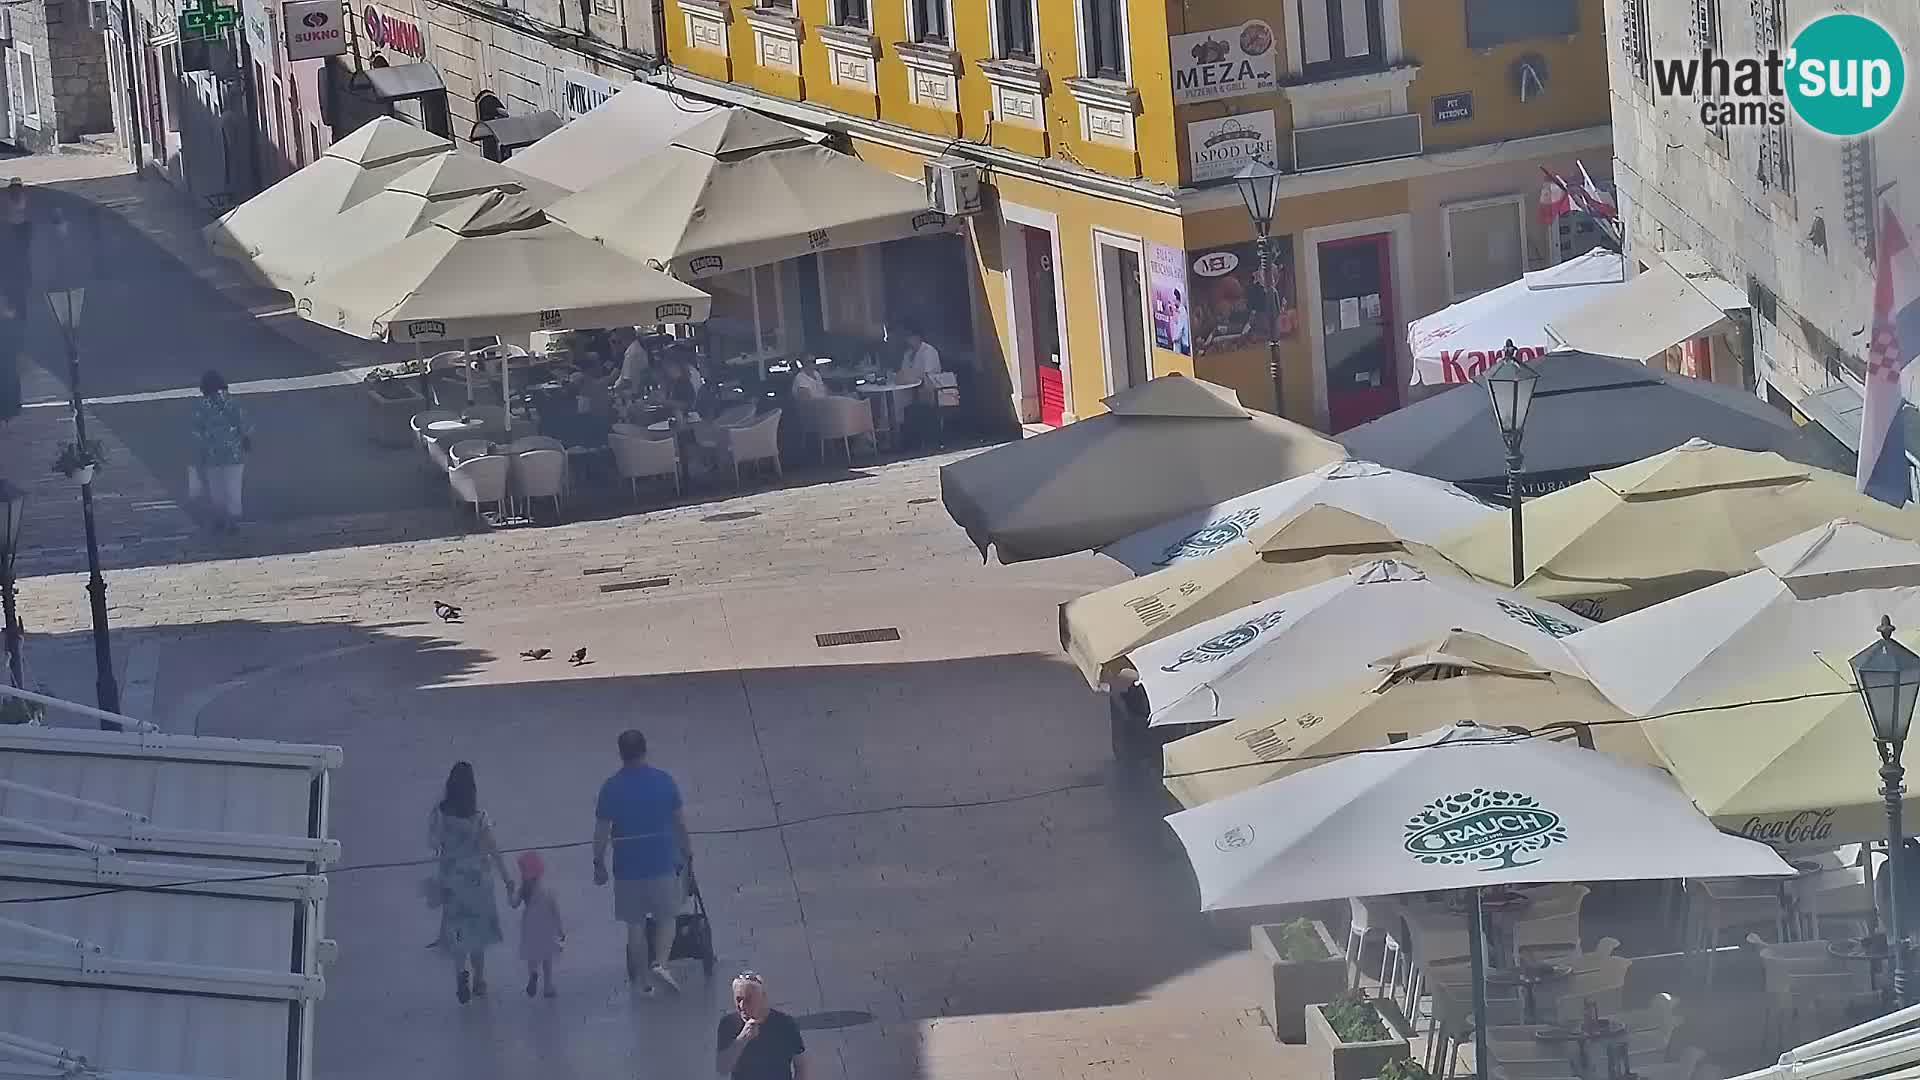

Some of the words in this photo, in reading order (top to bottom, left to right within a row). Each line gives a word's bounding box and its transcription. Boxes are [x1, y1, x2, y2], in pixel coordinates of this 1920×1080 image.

[295, 29, 339, 43] SUKNO
[381, 14, 421, 53] SUKNO
[1176, 60, 1255, 90] MEZA
[1195, 145, 1240, 164] ISPOD
[1443, 814, 1542, 844] RAUCH
